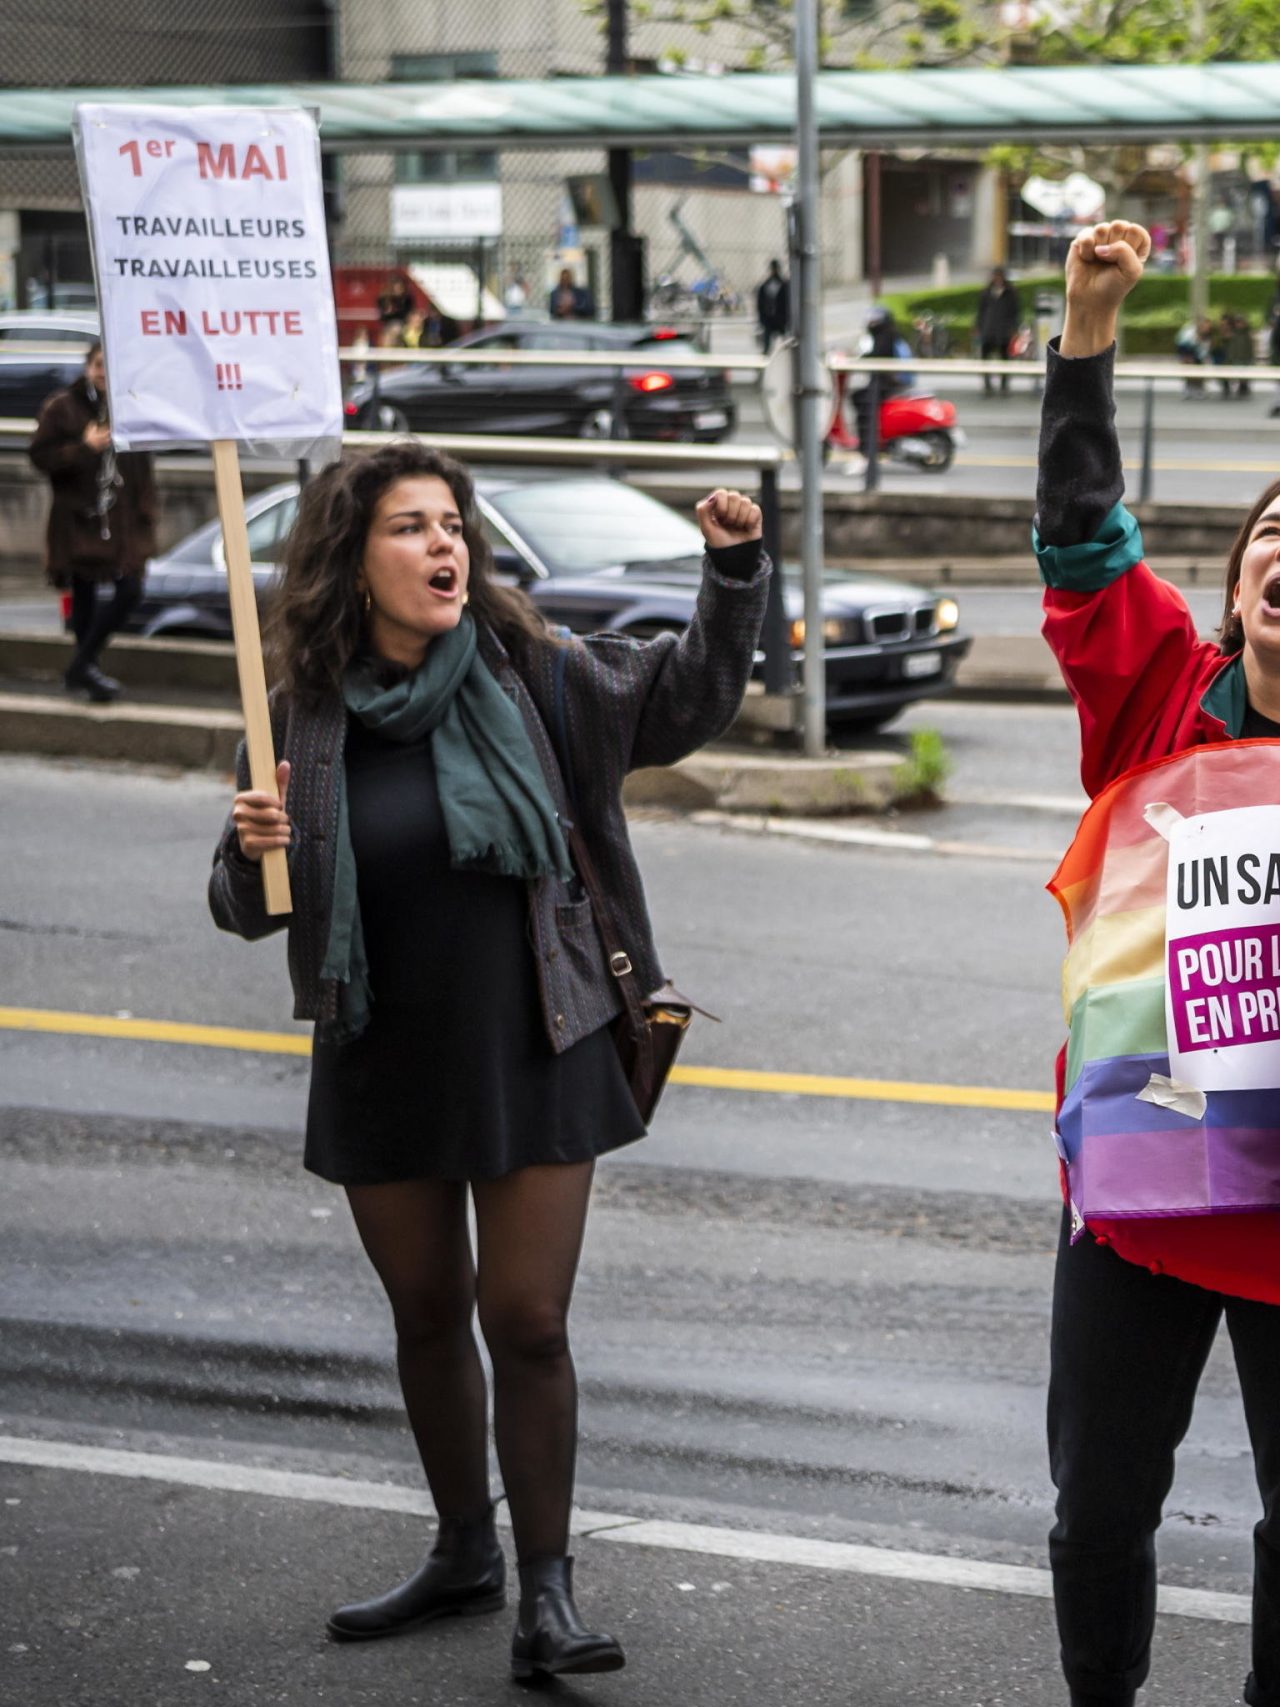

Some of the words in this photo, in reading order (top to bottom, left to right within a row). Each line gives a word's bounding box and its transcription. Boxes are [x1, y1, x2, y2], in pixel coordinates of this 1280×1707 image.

[119, 139, 176, 177] 1er
[196, 141, 288, 181] MAI
[116, 216, 306, 239] TRAVAILLEURS
[114, 258, 318, 279] TRAVAILLEUSES
[140, 310, 188, 336] EN
[202, 310, 304, 336] LUTTE
[215, 363, 243, 391] !!!
[1177, 855, 1229, 910] UN
[1177, 937, 1263, 992] POUR
[1185, 994, 1235, 1045] EN
